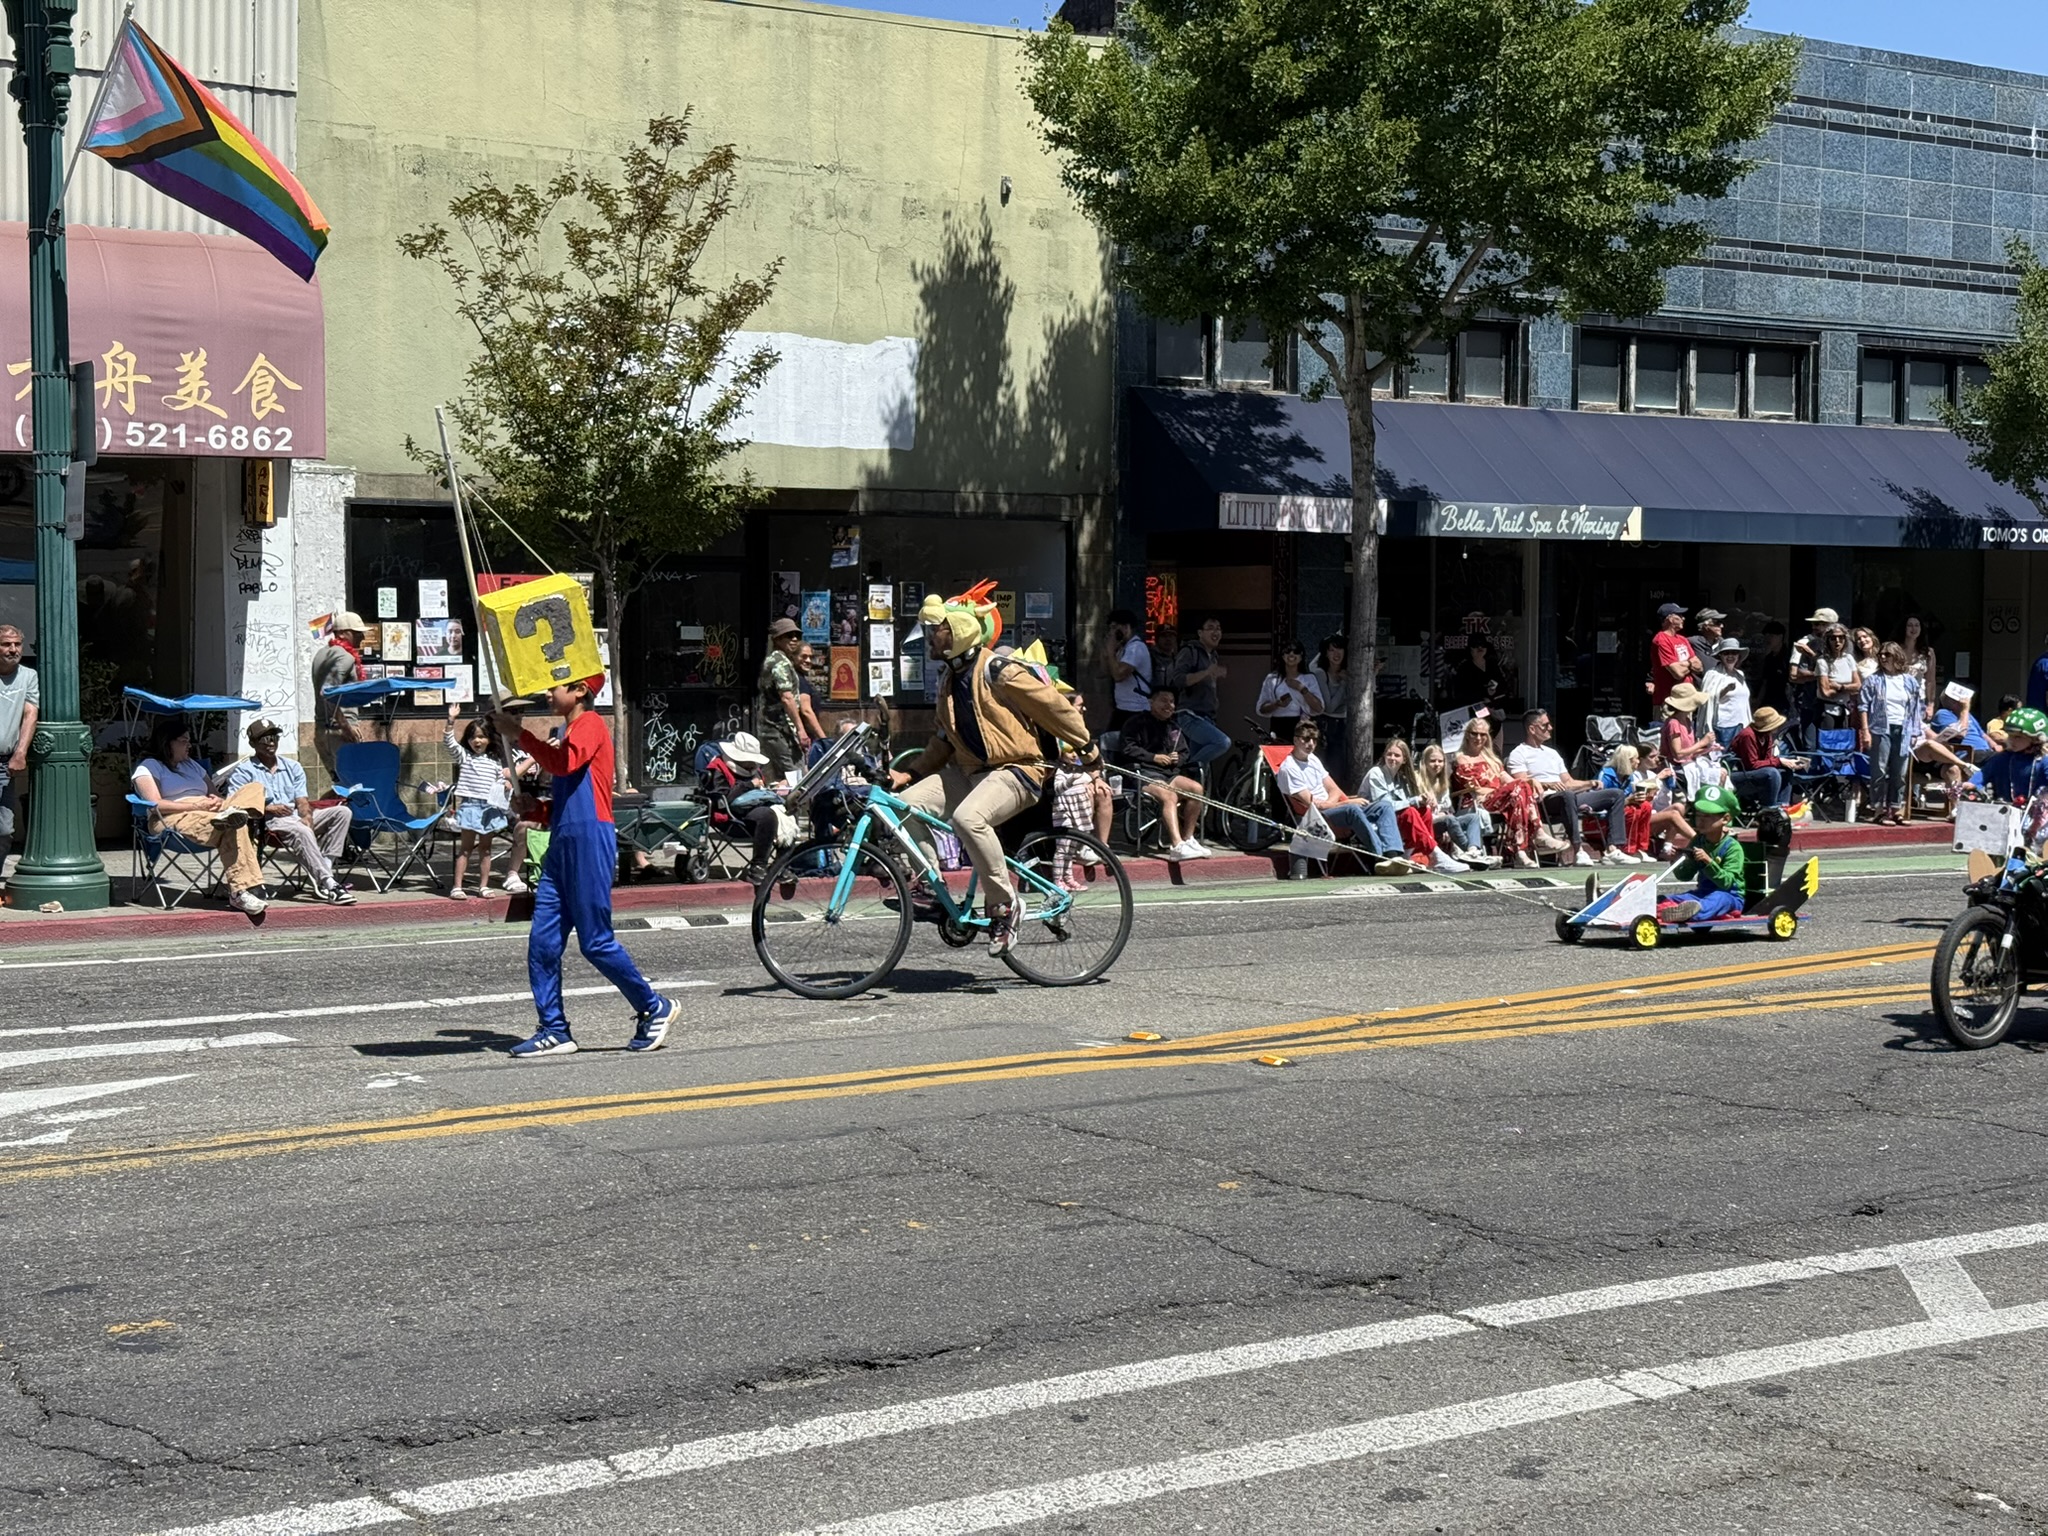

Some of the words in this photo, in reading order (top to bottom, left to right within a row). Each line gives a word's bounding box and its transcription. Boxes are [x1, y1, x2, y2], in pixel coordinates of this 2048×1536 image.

[125, 421, 293, 451] 521-6862
[1226, 500, 1277, 527] LITTLE
[1440, 504, 1486, 532] Bella
[1486, 506, 1525, 534] Nail
[1525, 510, 1552, 538] Spa
[1556, 508, 1570, 534] &
[1570, 511, 1620, 540] Waxing
[1982, 526, 2028, 543] TOMO'S
[238, 581, 278, 595] PABLO
[1461, 616, 1491, 634] TK
[1708, 789, 1715, 799] L
